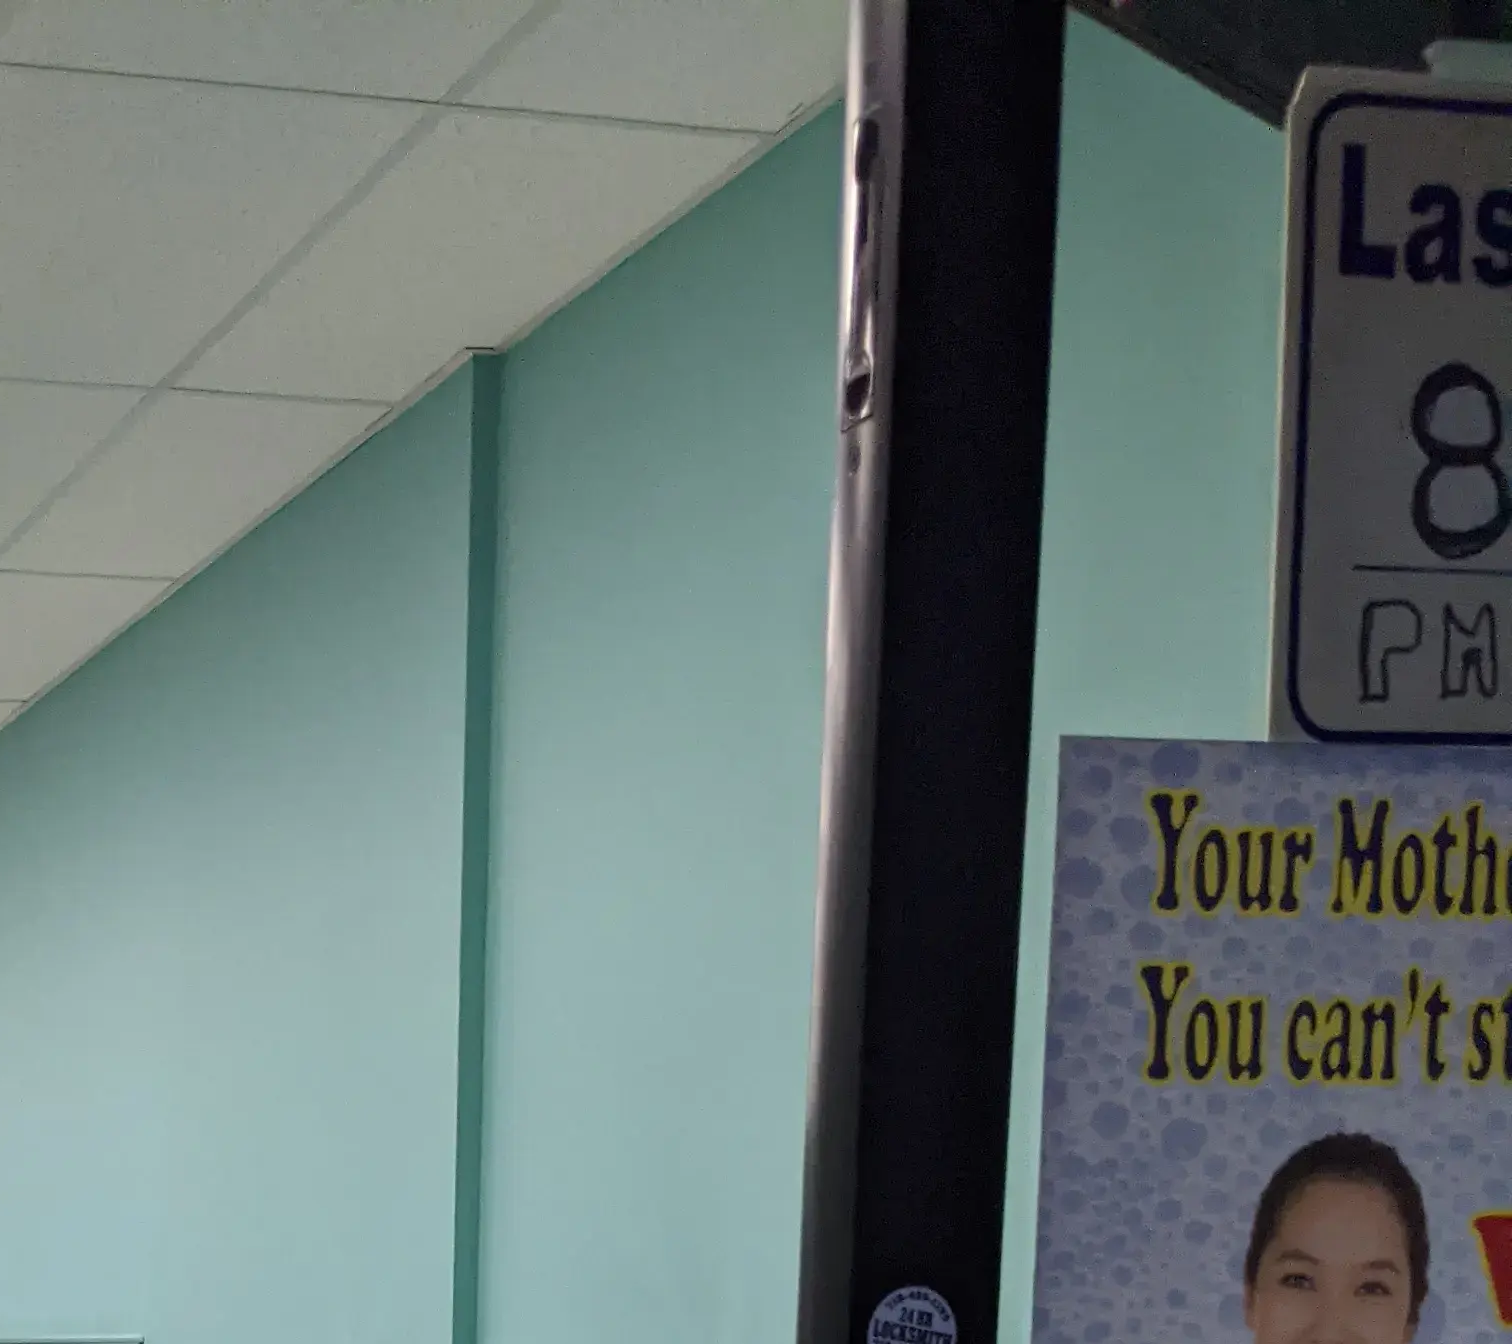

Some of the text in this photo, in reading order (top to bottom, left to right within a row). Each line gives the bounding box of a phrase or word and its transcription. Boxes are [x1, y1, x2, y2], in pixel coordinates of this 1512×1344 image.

[1411, 362, 1511, 559] 8
[1358, 599, 1497, 703] PM
[1150, 793, 1512, 916] Your Moth
[1139, 965, 1264, 1081] You
[1287, 968, 1451, 1081] can't
